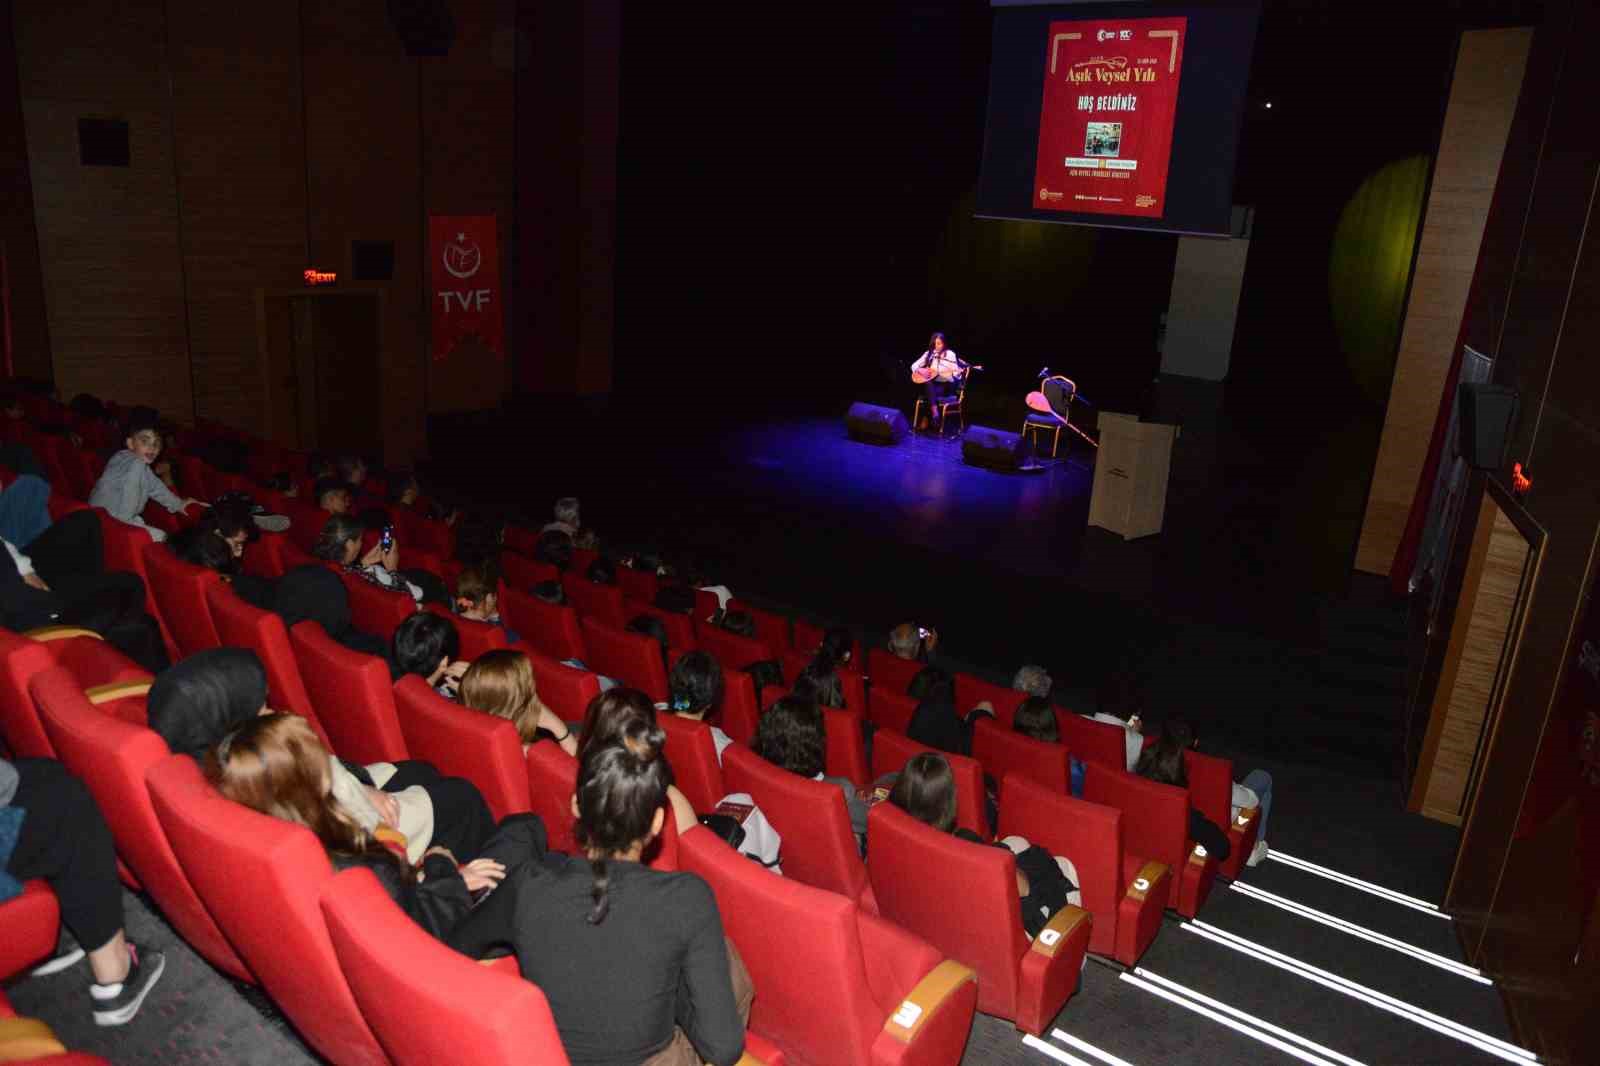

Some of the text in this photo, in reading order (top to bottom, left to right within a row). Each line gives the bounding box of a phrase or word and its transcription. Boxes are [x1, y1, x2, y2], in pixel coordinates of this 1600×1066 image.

[1066, 67, 1156, 86] Aşık Veysel Yılı
[1078, 93, 1137, 113] HOŞ GELDİNİZ
[316, 272, 337, 282] EXIT
[438, 288, 491, 313] TVF
